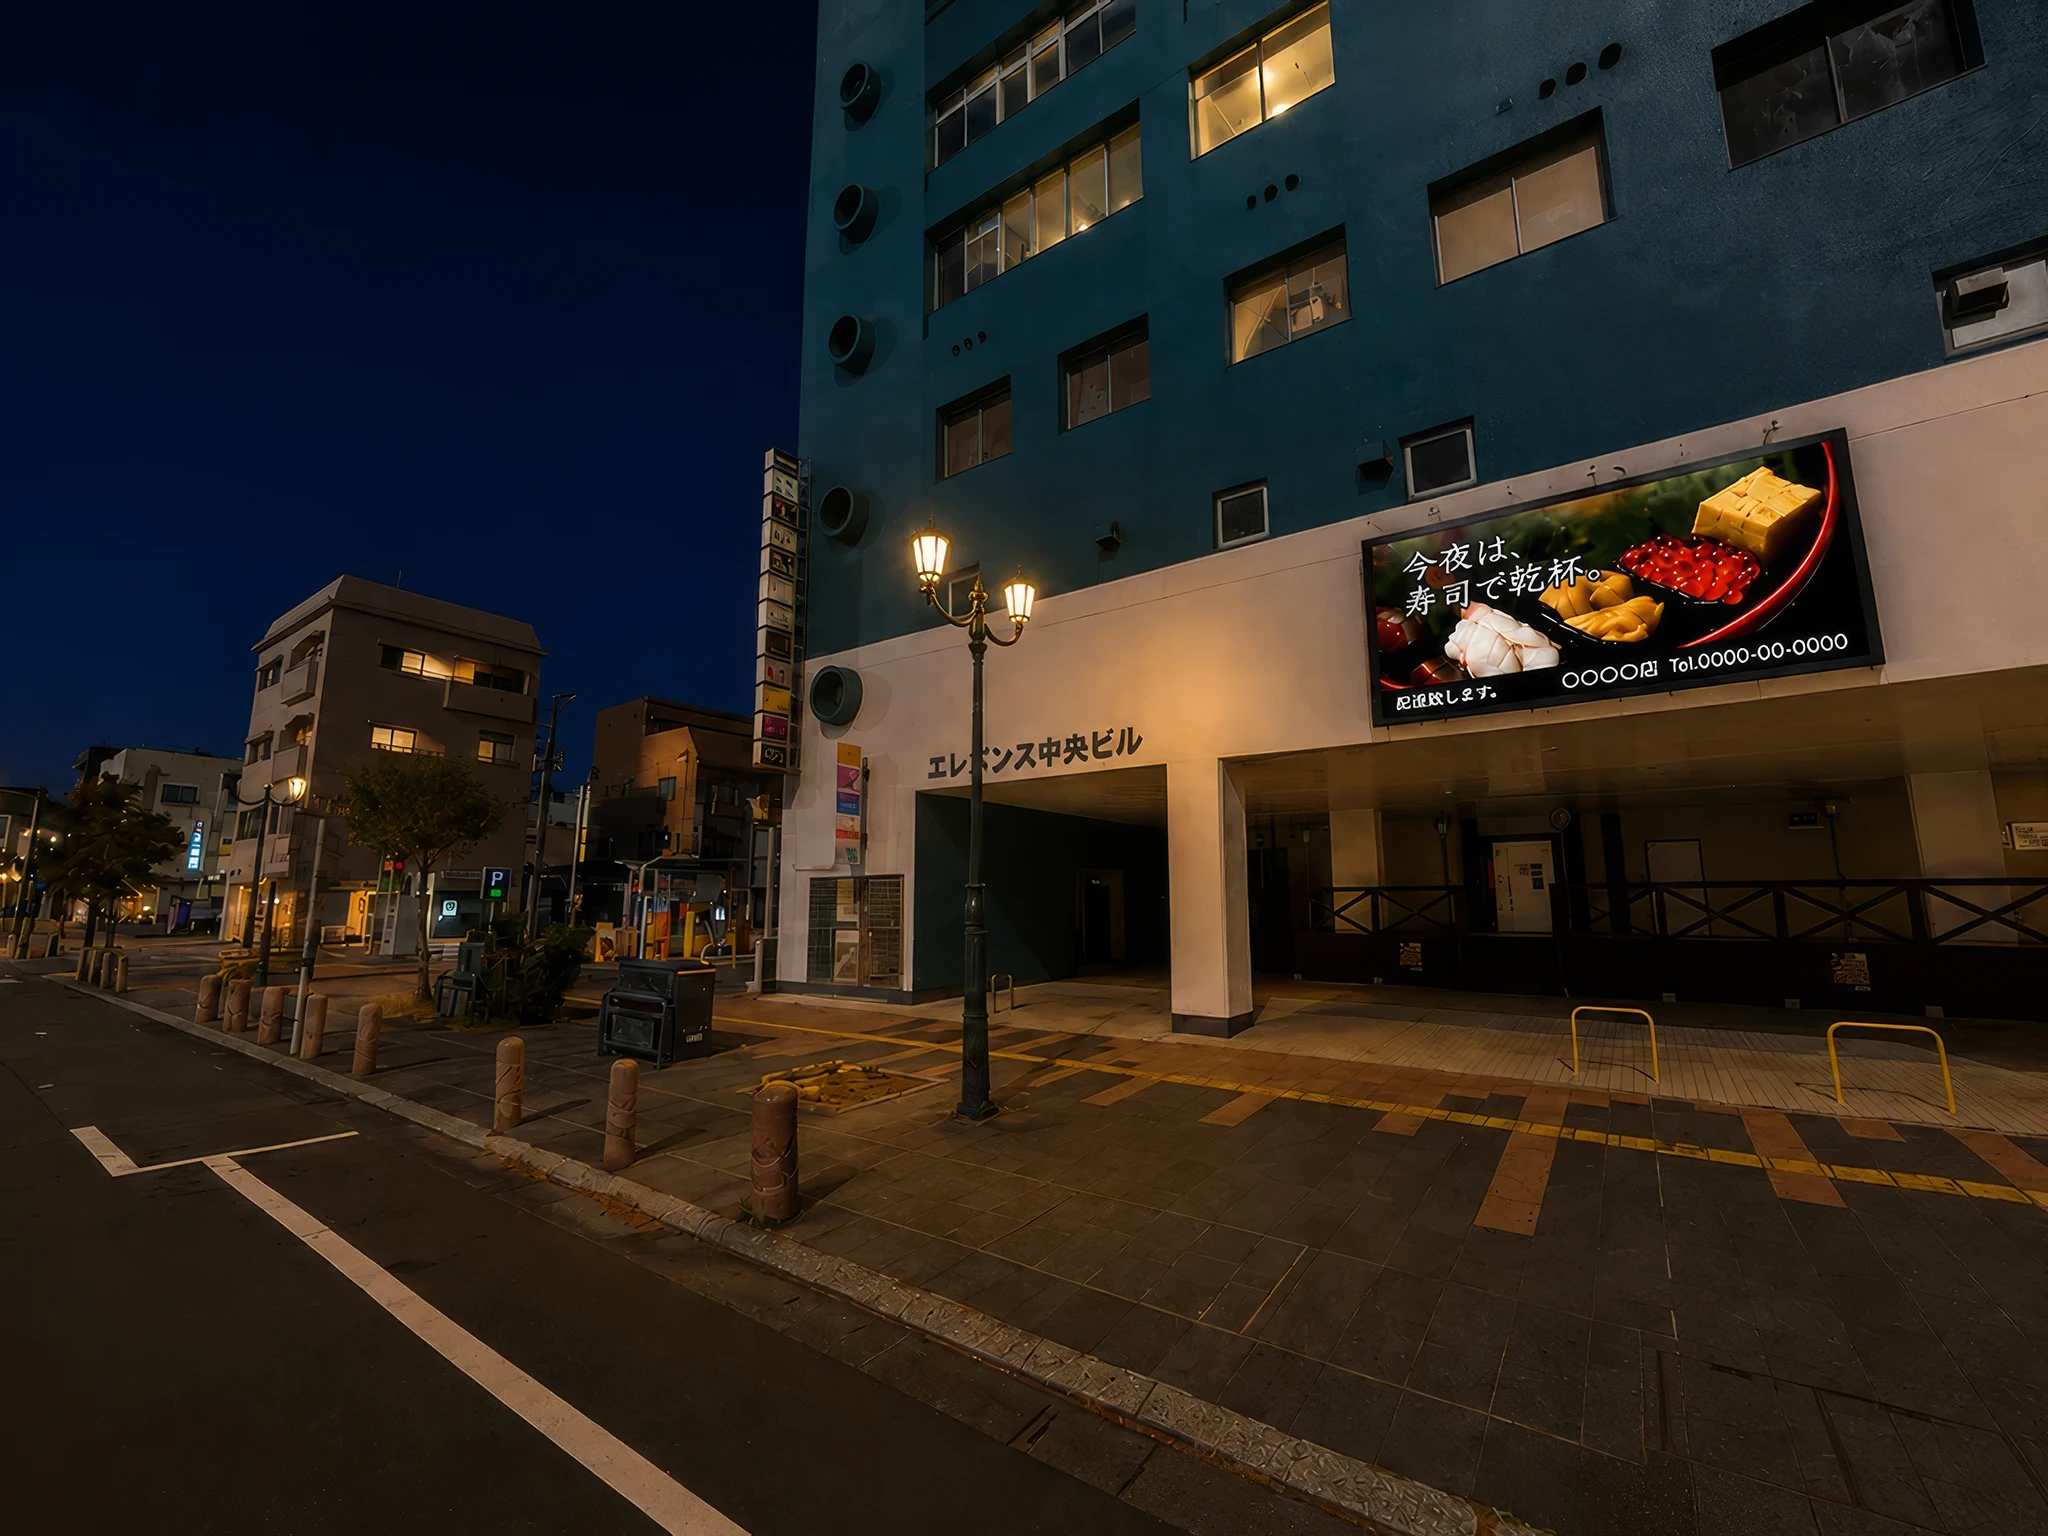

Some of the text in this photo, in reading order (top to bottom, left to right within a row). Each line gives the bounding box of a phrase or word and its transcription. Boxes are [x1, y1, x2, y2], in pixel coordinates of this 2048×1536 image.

[1403, 536, 1520, 580] 今夜は、
[1405, 555, 1600, 617] 寿司で乾杯。
[491, 871, 504, 886] P
